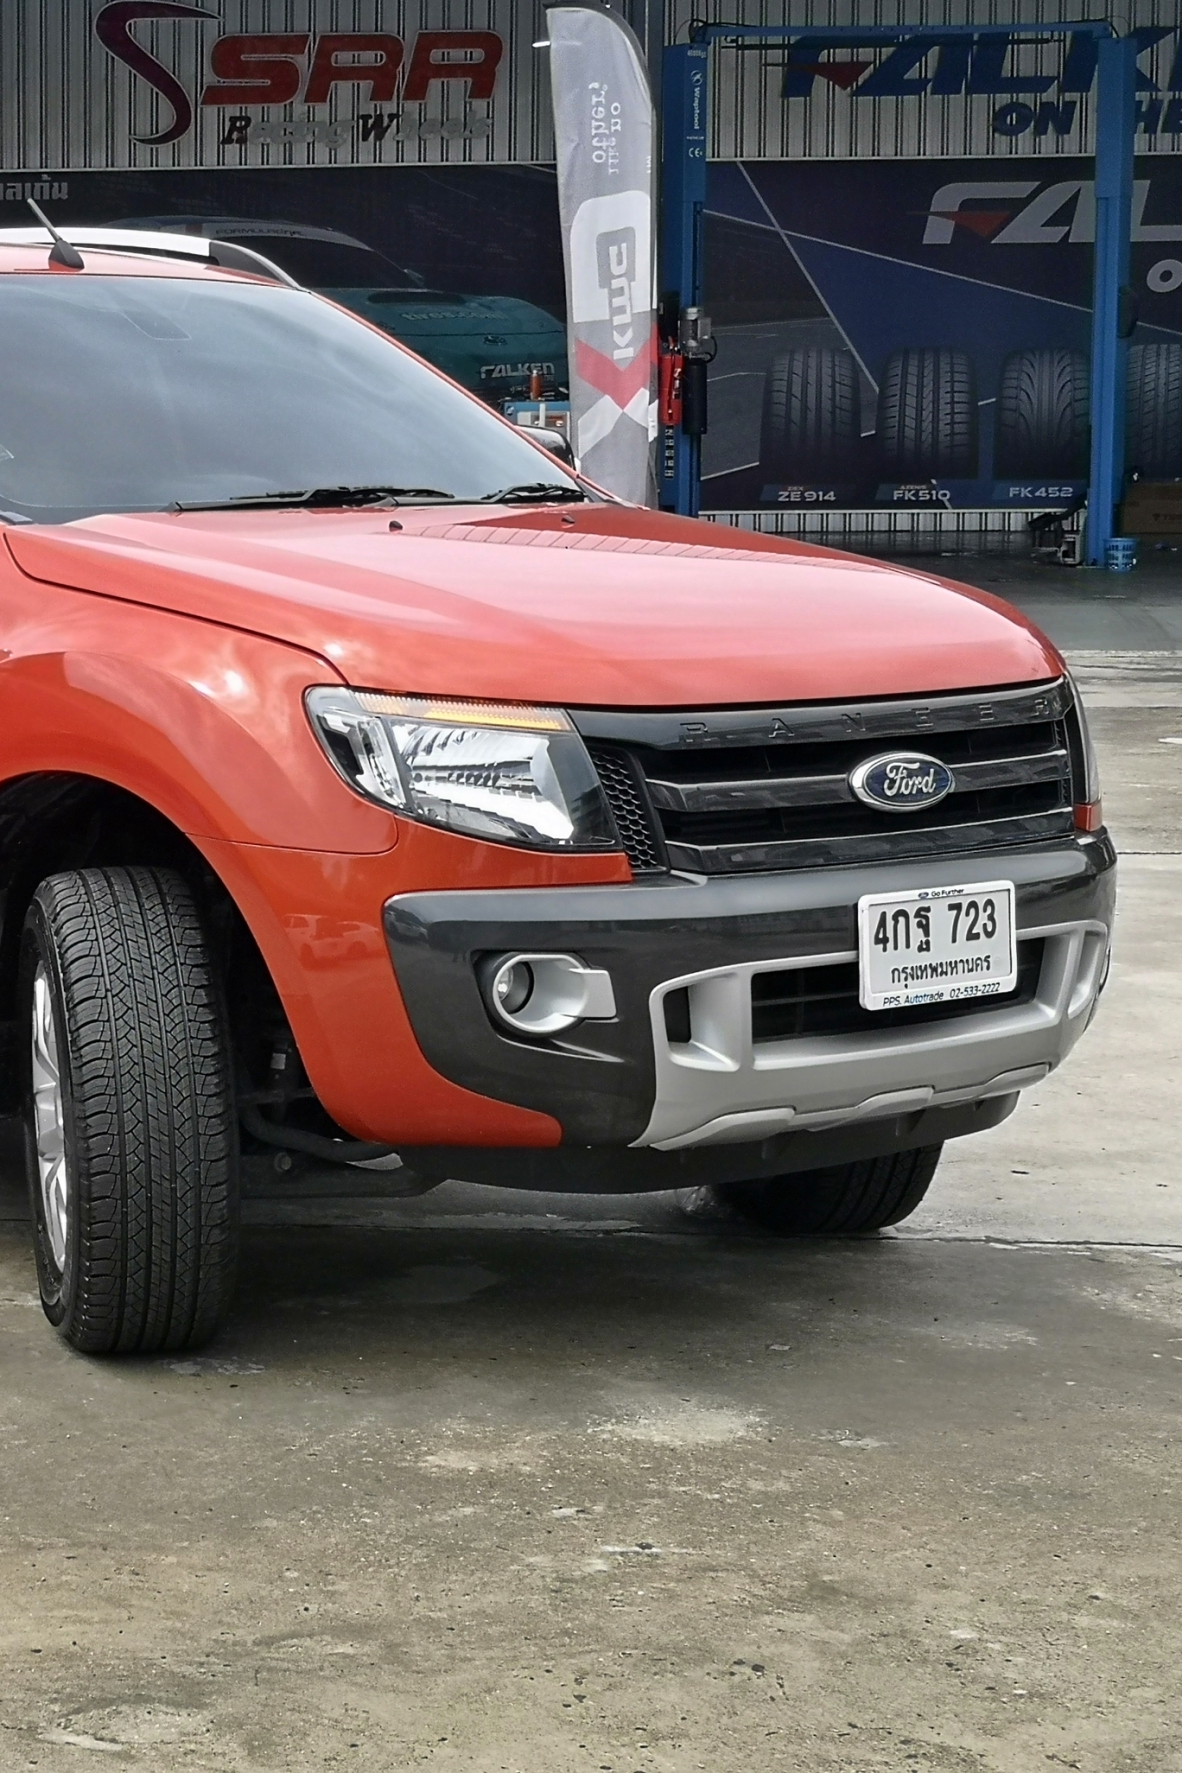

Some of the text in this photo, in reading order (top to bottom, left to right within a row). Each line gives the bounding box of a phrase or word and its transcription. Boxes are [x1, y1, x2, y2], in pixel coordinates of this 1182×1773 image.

[782, 25, 1182, 97] FALK
[993, 101, 1076, 136] ON
[480, 363, 555, 379] FALKEN
[883, 762, 936, 797] Ford
[947, 898, 997, 944] 723
[891, 954, 991, 989] กรุงเทพมหานคร
[904, 991, 944, 1004] Autotrade
[949, 982, 1001, 998] 02-533-2222
